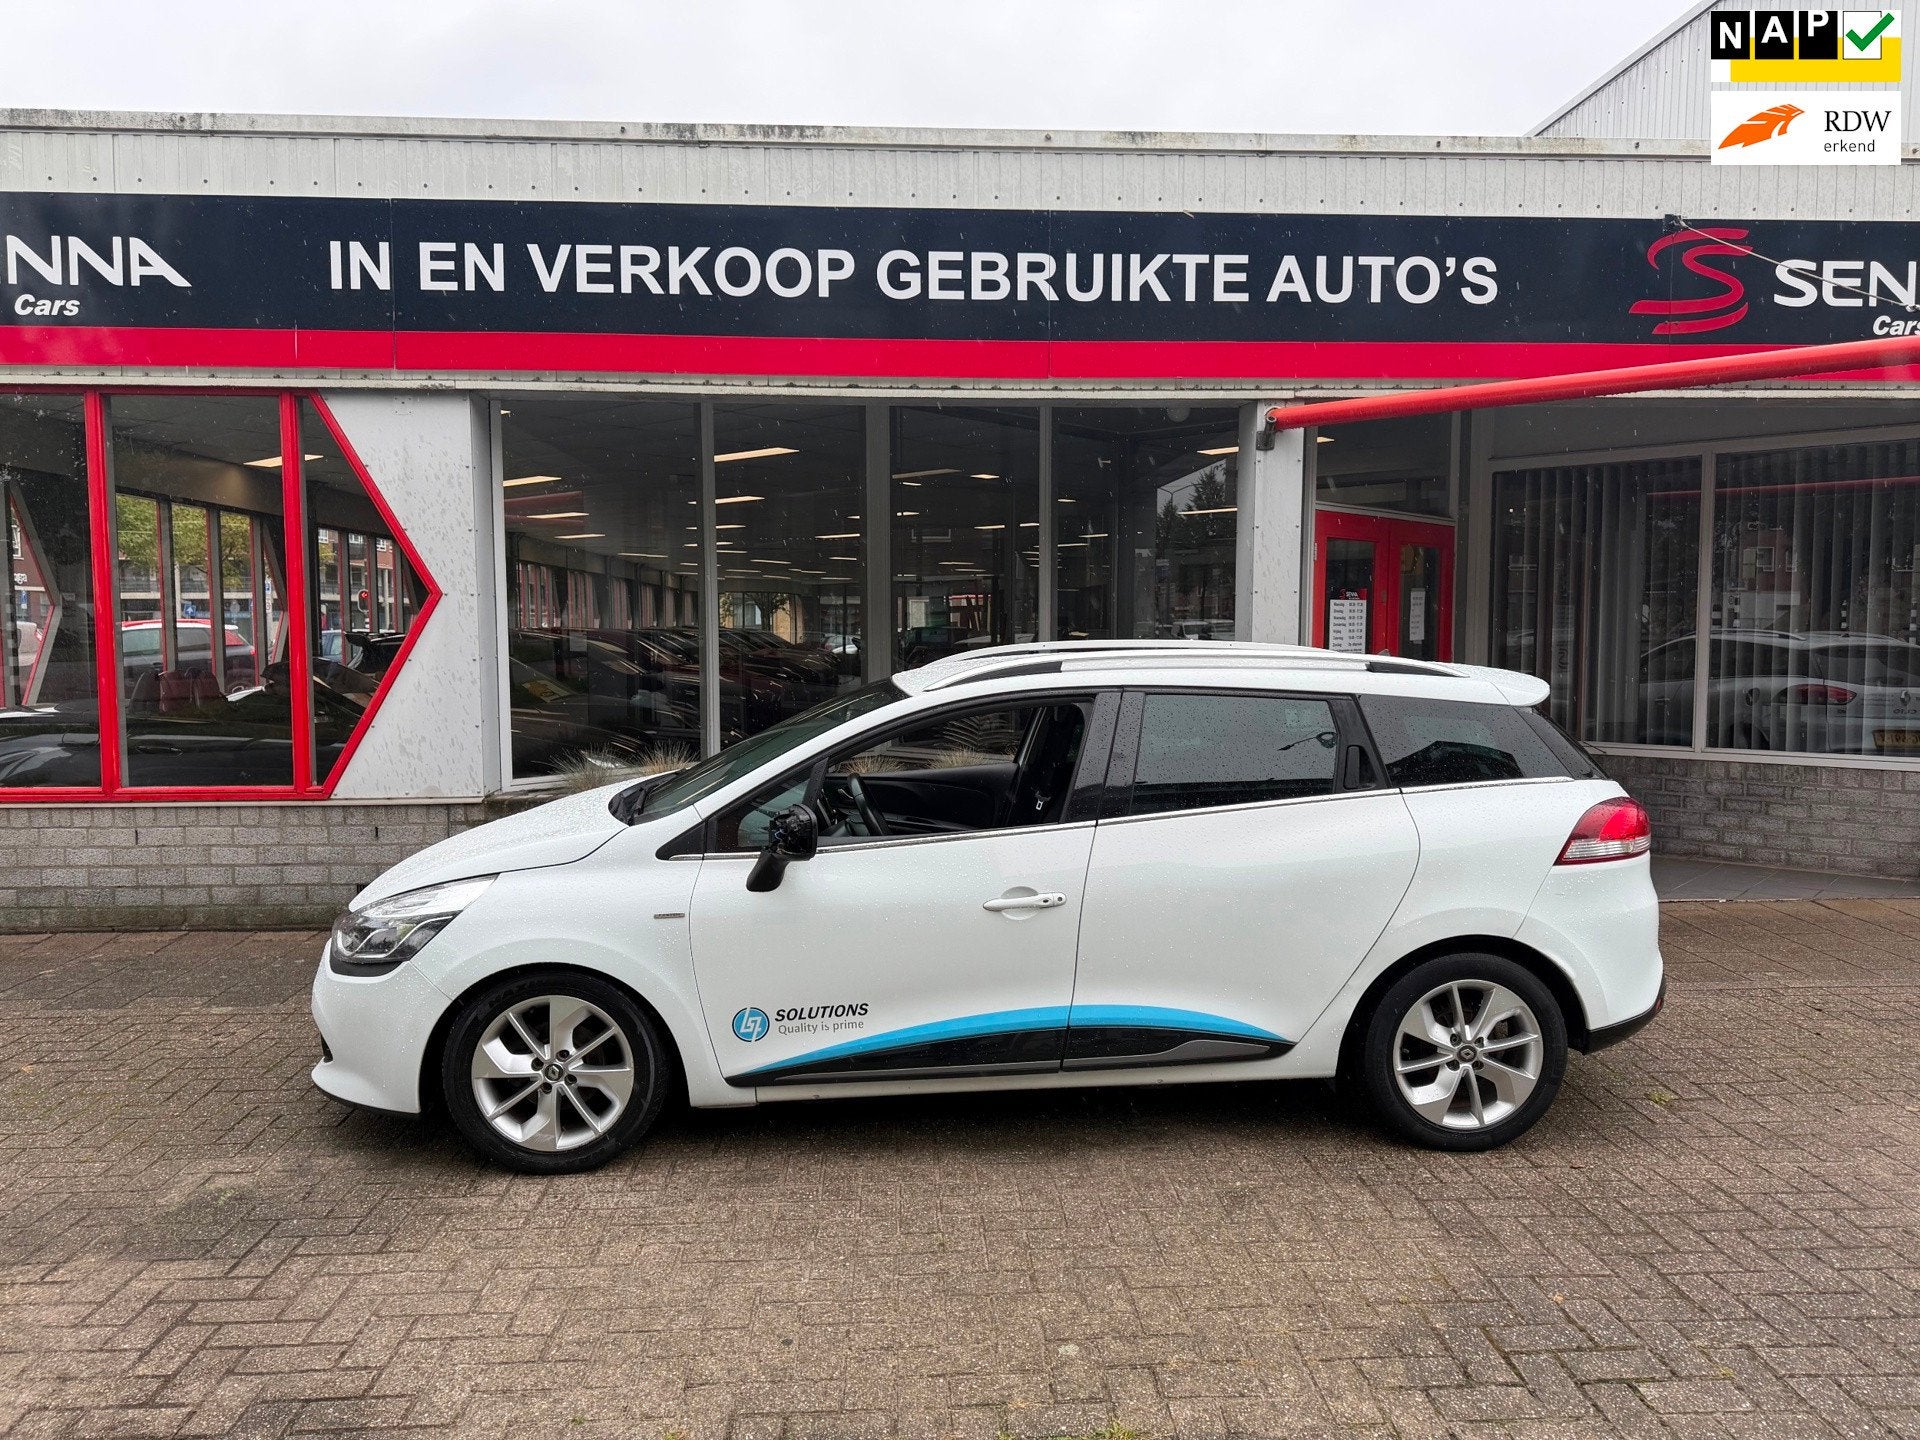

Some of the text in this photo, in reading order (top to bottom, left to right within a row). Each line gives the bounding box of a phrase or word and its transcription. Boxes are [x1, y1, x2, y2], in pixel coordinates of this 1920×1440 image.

[6, 234, 192, 287] NNA
[329, 240, 1498, 304] IN EN VERKOOP GEBRUIKTE AUTO’S
[14, 293, 81, 317] Cars
[774, 1002, 869, 1022] SOLUTIONS
[778, 1020, 864, 1035] Quality is prime
